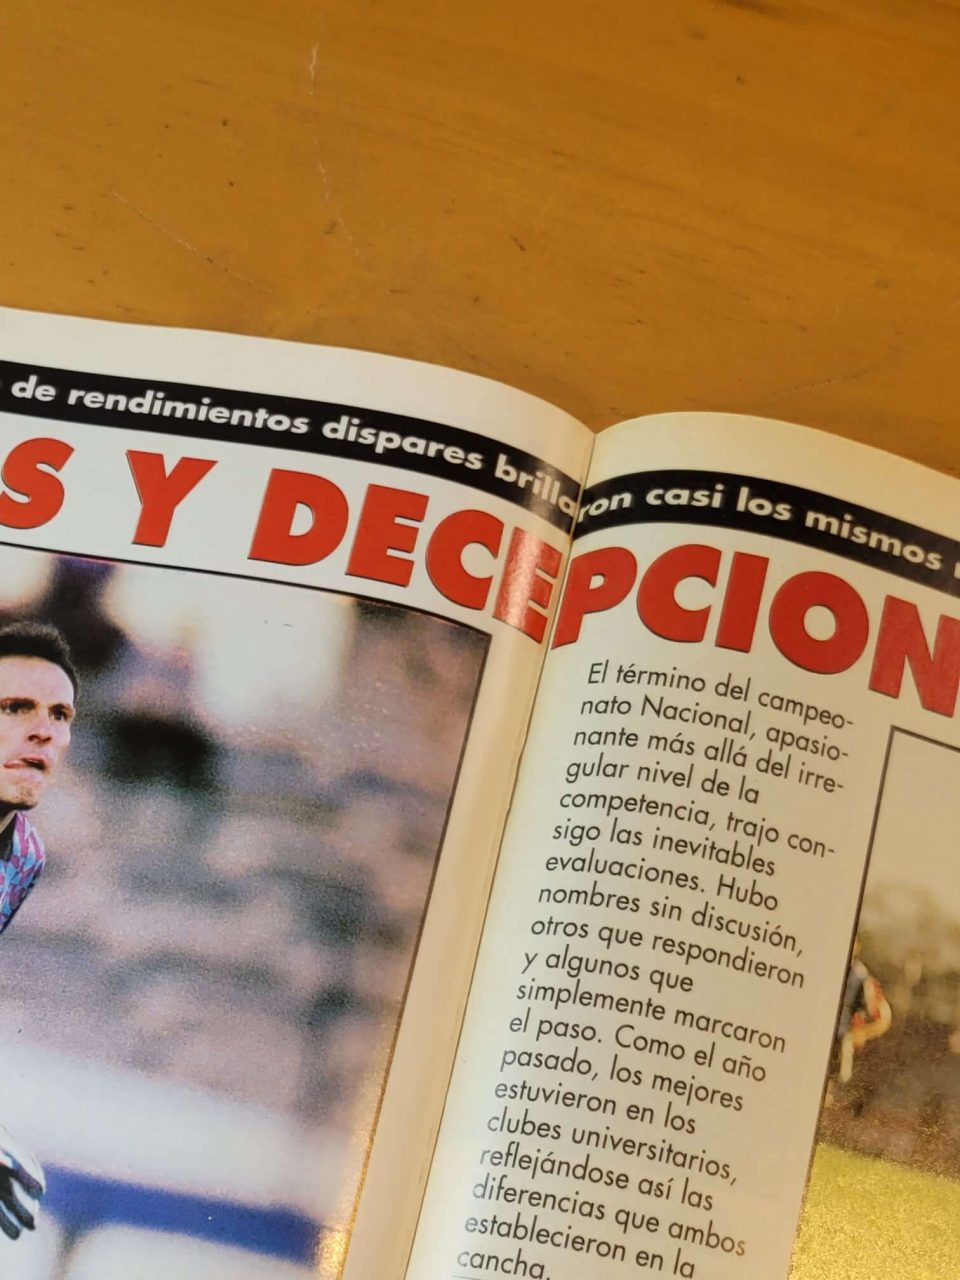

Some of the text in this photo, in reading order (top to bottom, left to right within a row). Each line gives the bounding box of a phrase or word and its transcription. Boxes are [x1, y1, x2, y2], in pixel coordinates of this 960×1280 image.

[11, 374, 57, 402] de
[68, 389, 310, 434] rendimientos
[322, 414, 484, 471] dispares
[645, 483, 726, 508] casi
[736, 486, 793, 521] los
[804, 509, 942, 571] mismos
[125, 448, 218, 548] Y
[587, 659, 610, 684] El
[616, 663, 706, 692] término
[714, 672, 752, 702] del
[580, 695, 632, 715] nato
[640, 694, 756, 741] Nacional,
[565, 752, 760, 805] gular nivel de la
[573, 727, 639, 748] nante
[647, 732, 695, 756] más
[704, 737, 748, 768] allá
[756, 748, 792, 779] del
[552, 817, 775, 877] sigo las inevitables
[559, 793, 716, 831] competencia,
[726, 811, 779, 847] trajo
[545, 847, 779, 911] evaluaciones. Hubo
[538, 880, 803, 958] nombres sin discusión,
[521, 943, 694, 994] y algunos que
[531, 916, 804, 989] otros que respondieron
[516, 977, 786, 1054] simplemente marcaron
[500, 1046, 743, 1112] pasado, los mejores
